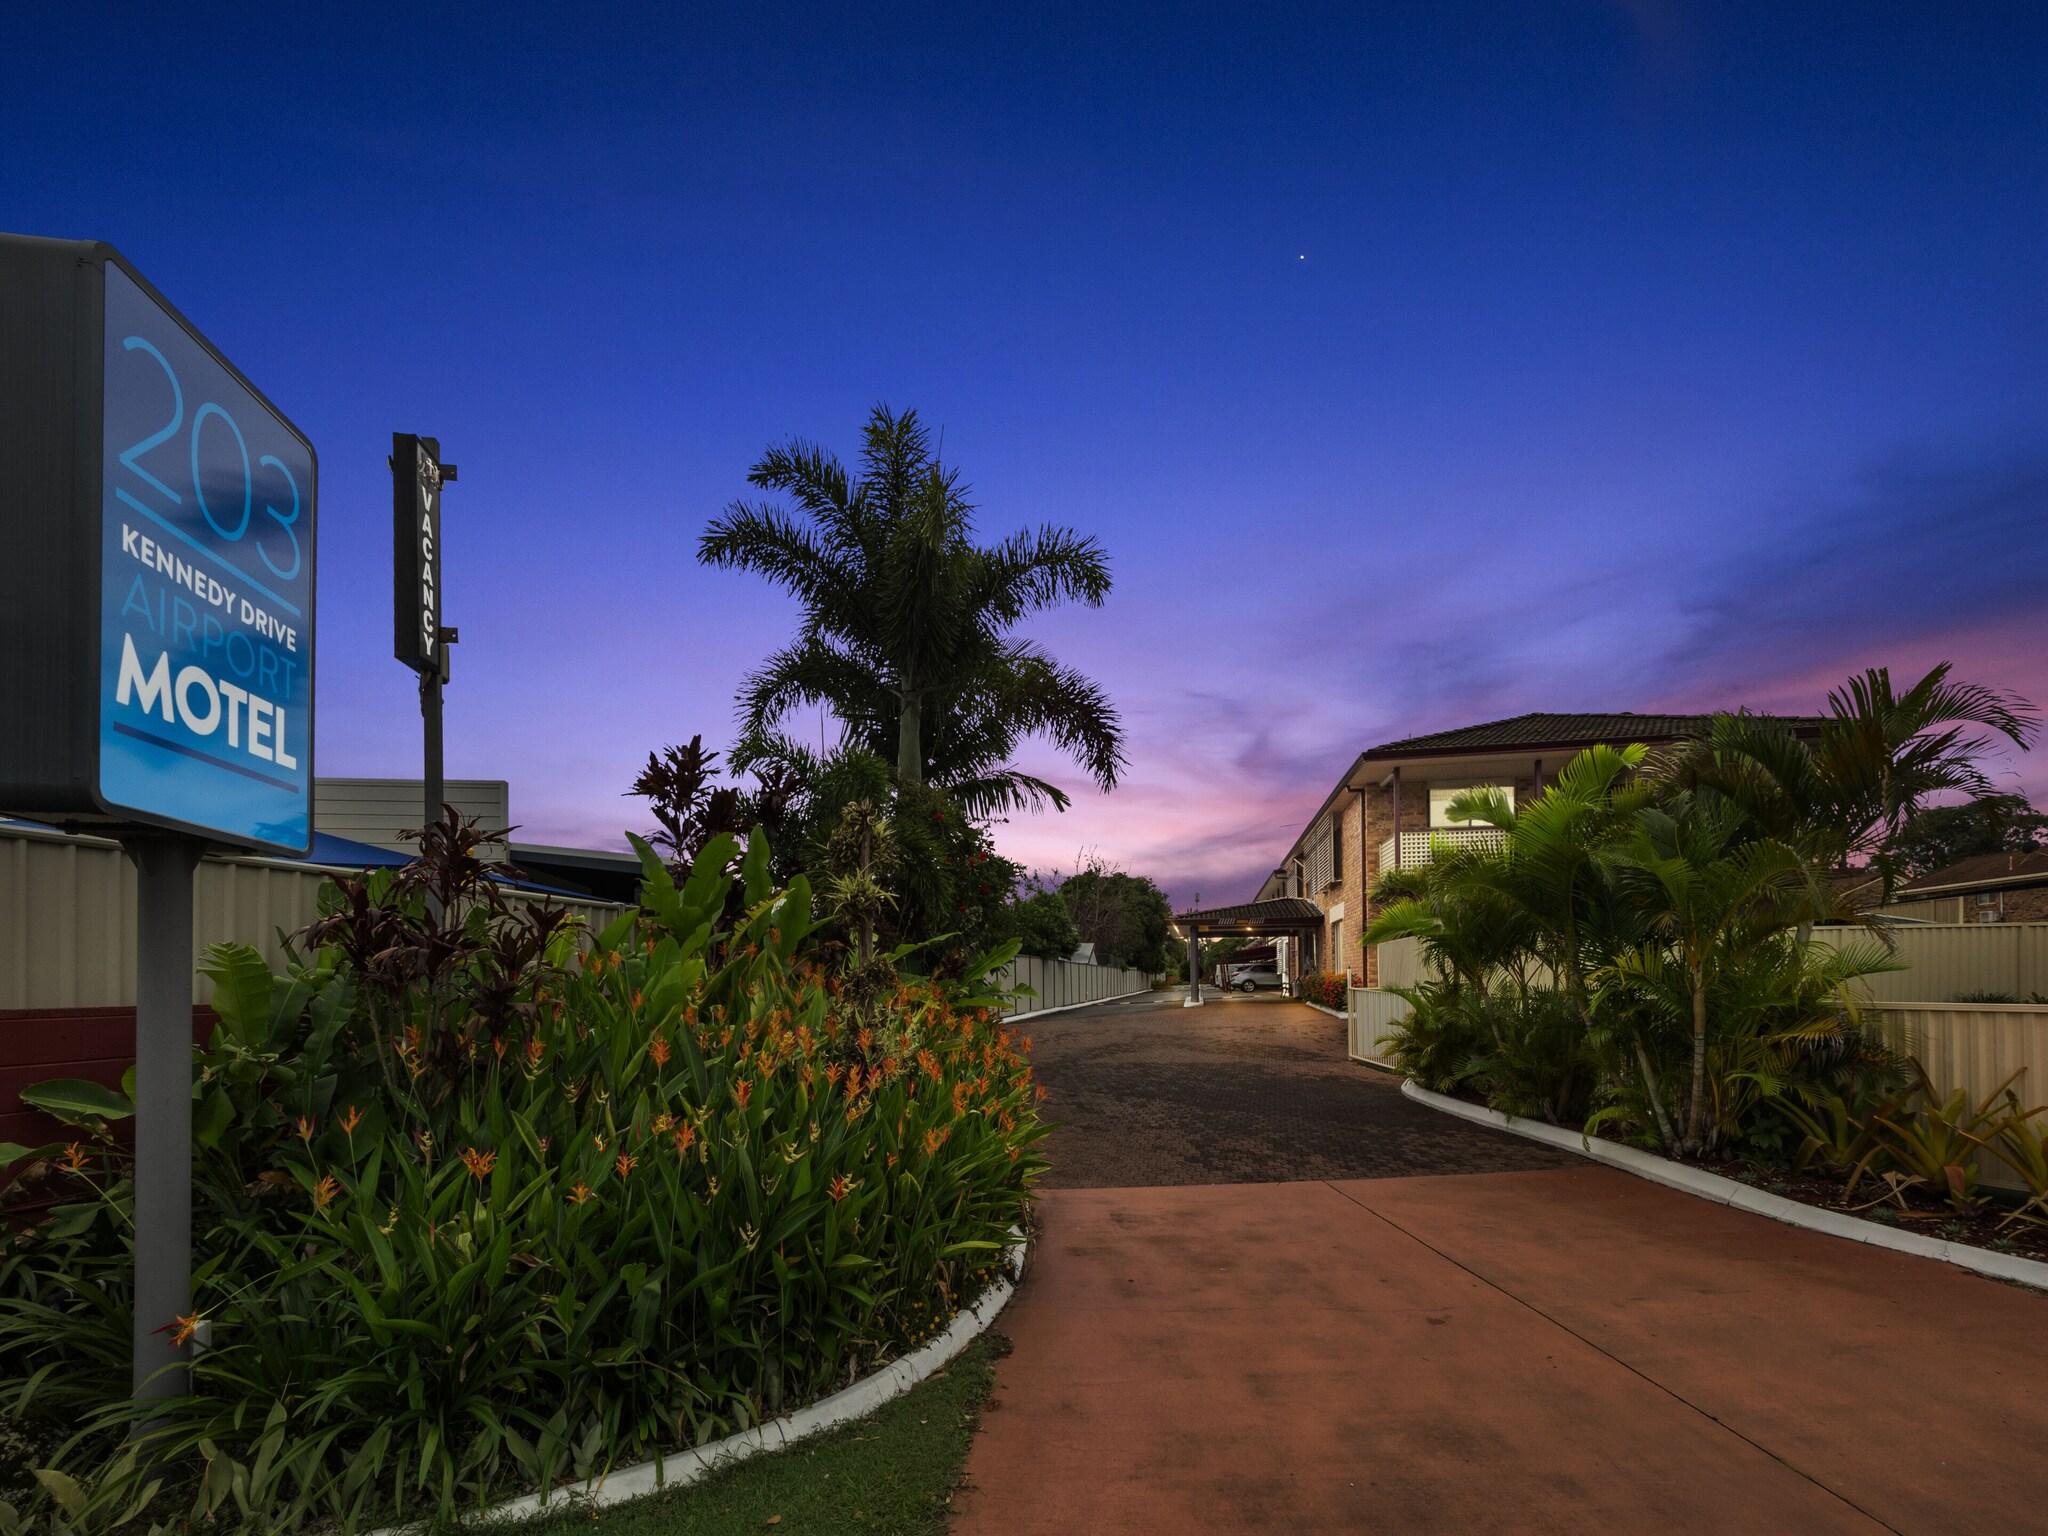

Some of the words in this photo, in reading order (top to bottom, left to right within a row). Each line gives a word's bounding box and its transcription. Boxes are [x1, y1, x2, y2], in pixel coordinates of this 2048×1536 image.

[119, 336, 301, 581] 203
[121, 573, 297, 700] AIRPORT
[122, 523, 236, 615] KENNEDY
[240, 594, 297, 653] DRIVE
[421, 485, 435, 656] VACANCY
[116, 632, 297, 771] MOTEL
